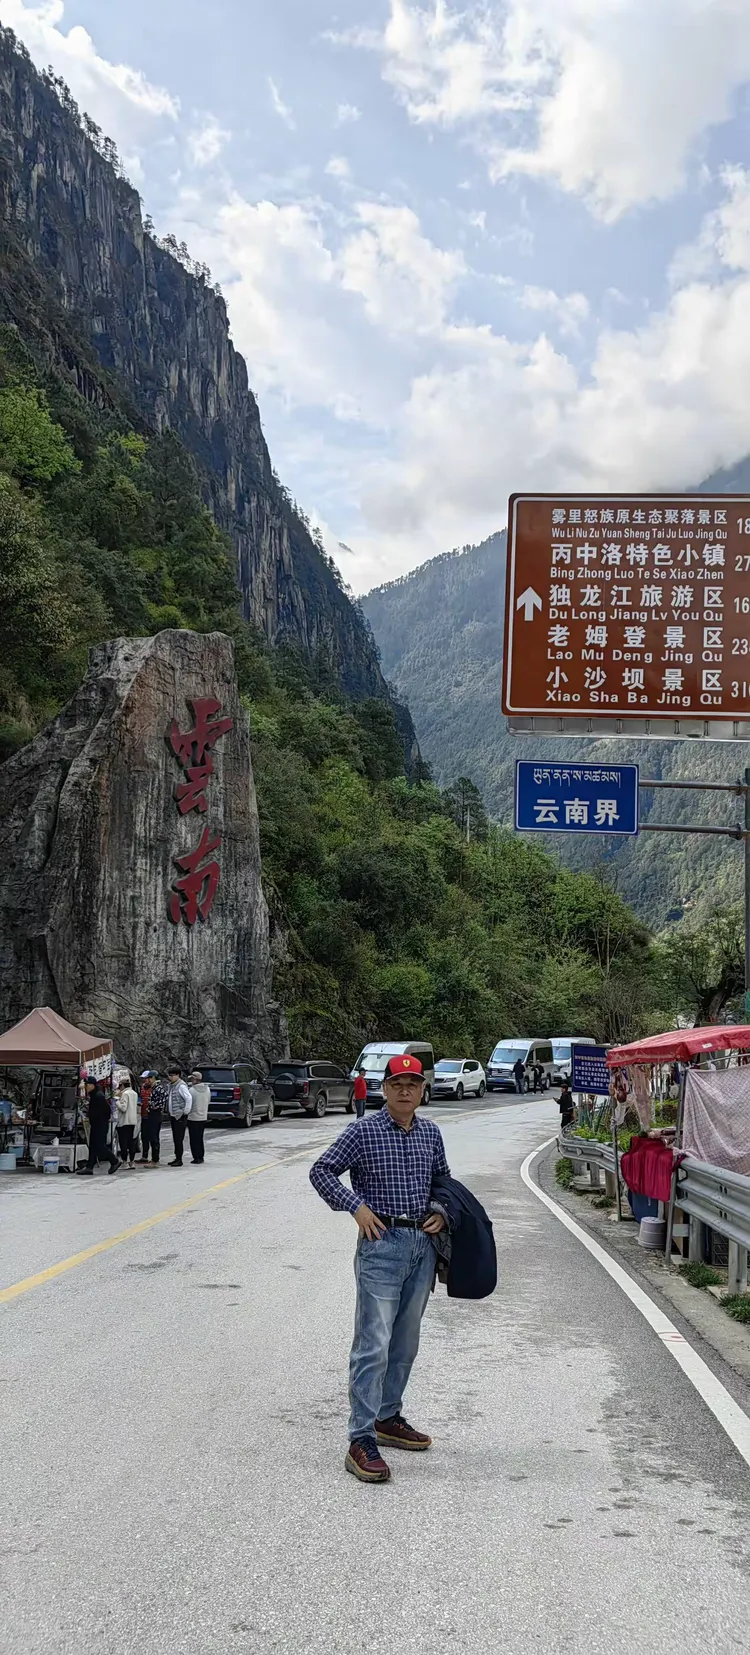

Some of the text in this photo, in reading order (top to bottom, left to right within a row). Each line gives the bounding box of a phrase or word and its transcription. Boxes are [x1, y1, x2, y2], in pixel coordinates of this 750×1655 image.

[552, 509, 727, 524] 雾里怒族原生态聚落景区
[552, 528, 727, 541] Wu Li Nu Zu Yuan Sheng Tai Ju Luo Jing Qu
[551, 543, 725, 566] 丙中洛特色小镇
[551, 567, 723, 580] Bing Zhong Luo Te Se Xiao Zhen
[549, 584, 724, 607] 独龙江旅游区
[550, 608, 722, 622] Du Long Jiang Lv You Qu
[548, 624, 724, 648] 老姆登景区
[548, 648, 722, 663] Lao Mu Deng Jing Qu
[546, 666, 722, 690] 小沙坝景区
[546, 690, 721, 706] Xiao Sha Ba Jing Qu
[533, 797, 620, 826] 云南界
